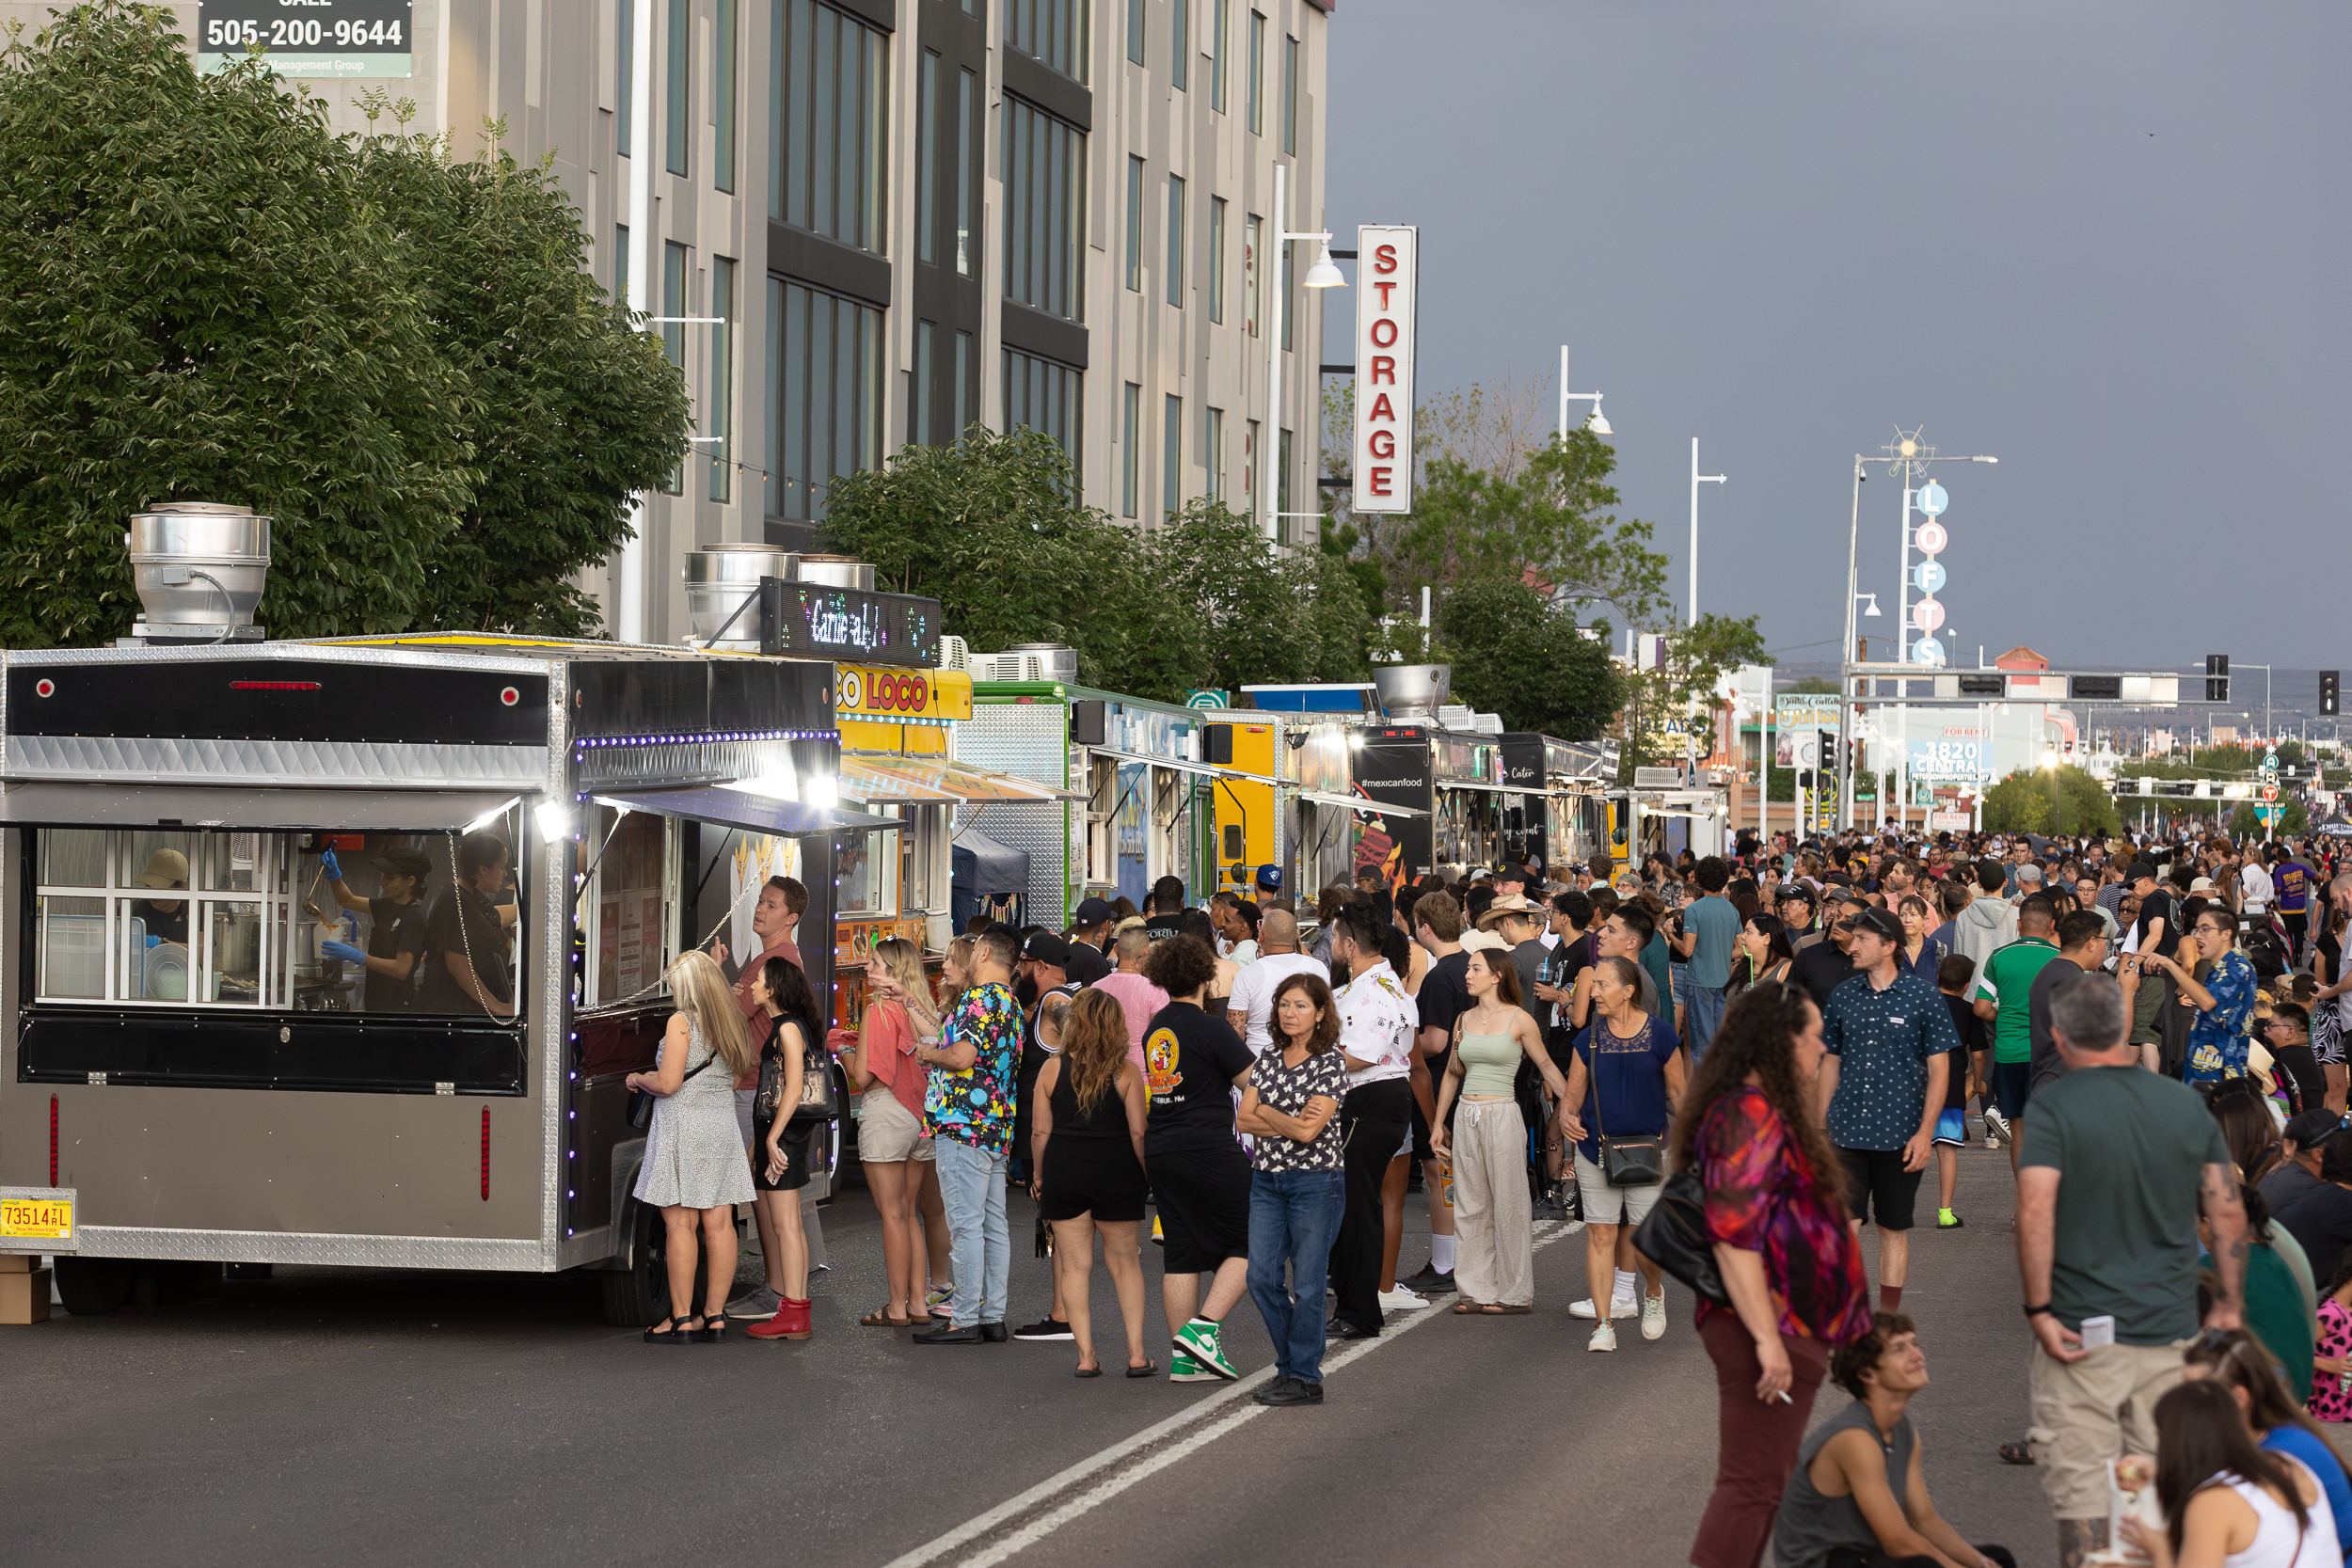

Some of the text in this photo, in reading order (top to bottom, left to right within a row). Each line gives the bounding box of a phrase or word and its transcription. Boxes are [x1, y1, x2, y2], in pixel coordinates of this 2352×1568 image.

[207, 19, 403, 46] 505-200-9644
[270, 59, 332, 72] Management
[334, 59, 364, 72] Group
[1370, 244, 1399, 497] STORAGE
[1919, 487, 1943, 665] LOFTS
[866, 673, 928, 713] LOCO
[1945, 727, 1963, 736] FOR
[1925, 741, 1978, 760] 3820
[1511, 767, 1534, 779] Cater
[1915, 759, 1985, 773] CENTRA
[1361, 778, 1422, 788] #mexicanfood
